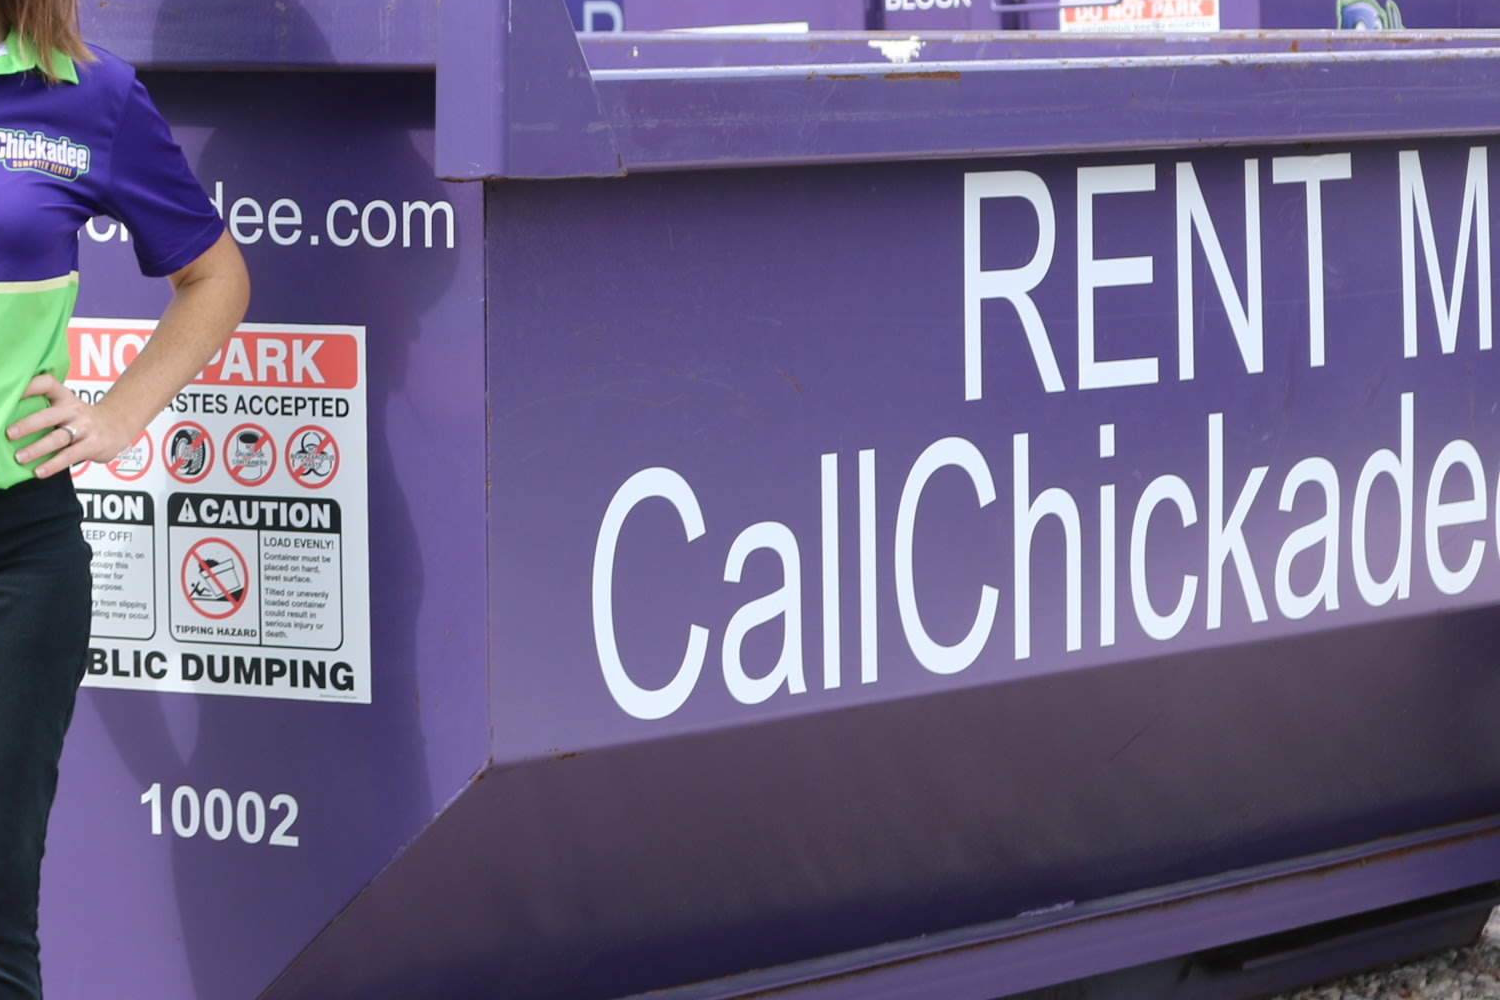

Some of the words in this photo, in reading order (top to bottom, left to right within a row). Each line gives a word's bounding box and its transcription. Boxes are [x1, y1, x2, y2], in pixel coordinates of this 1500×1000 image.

[1107, 1, 1146, 19] NOT
[1151, 0, 1203, 17] PARK
[964, 153, 1352, 400] RENT
[234, 395, 349, 418] ACCEPTED
[76, 493, 144, 521] TION
[199, 498, 331, 529] CAUTION
[82, 529, 106, 541] EEP
[109, 531, 132, 542] OFF!
[264, 536, 291, 547] LOAD
[294, 538, 334, 550] EVENLY!
[263, 552, 300, 561] Container
[301, 554, 320, 562] must
[322, 555, 331, 563] be
[592, 393, 1500, 720] CallChickade
[264, 563, 288, 572] placed
[301, 564, 321, 574] hard,
[264, 573, 281, 581] level
[283, 574, 312, 583] surface.
[265, 587, 285, 596] Tilted
[296, 590, 329, 600] unevenly
[100, 599, 117, 607] from
[119, 599, 147, 610] slipping
[264, 598, 290, 607] loaded
[291, 600, 326, 609] container
[111, 612, 127, 620] may
[287, 610, 308, 618] result
[309, 611, 317, 619] in
[175, 624, 214, 636] TIPPING
[217, 627, 257, 638] HAZARD
[265, 620, 292, 628] serious
[294, 621, 314, 631] injury
[265, 630, 288, 638] death.
[87, 647, 167, 680] BLIC
[180, 653, 355, 692] DUMPING
[141, 783, 299, 847] 10002
